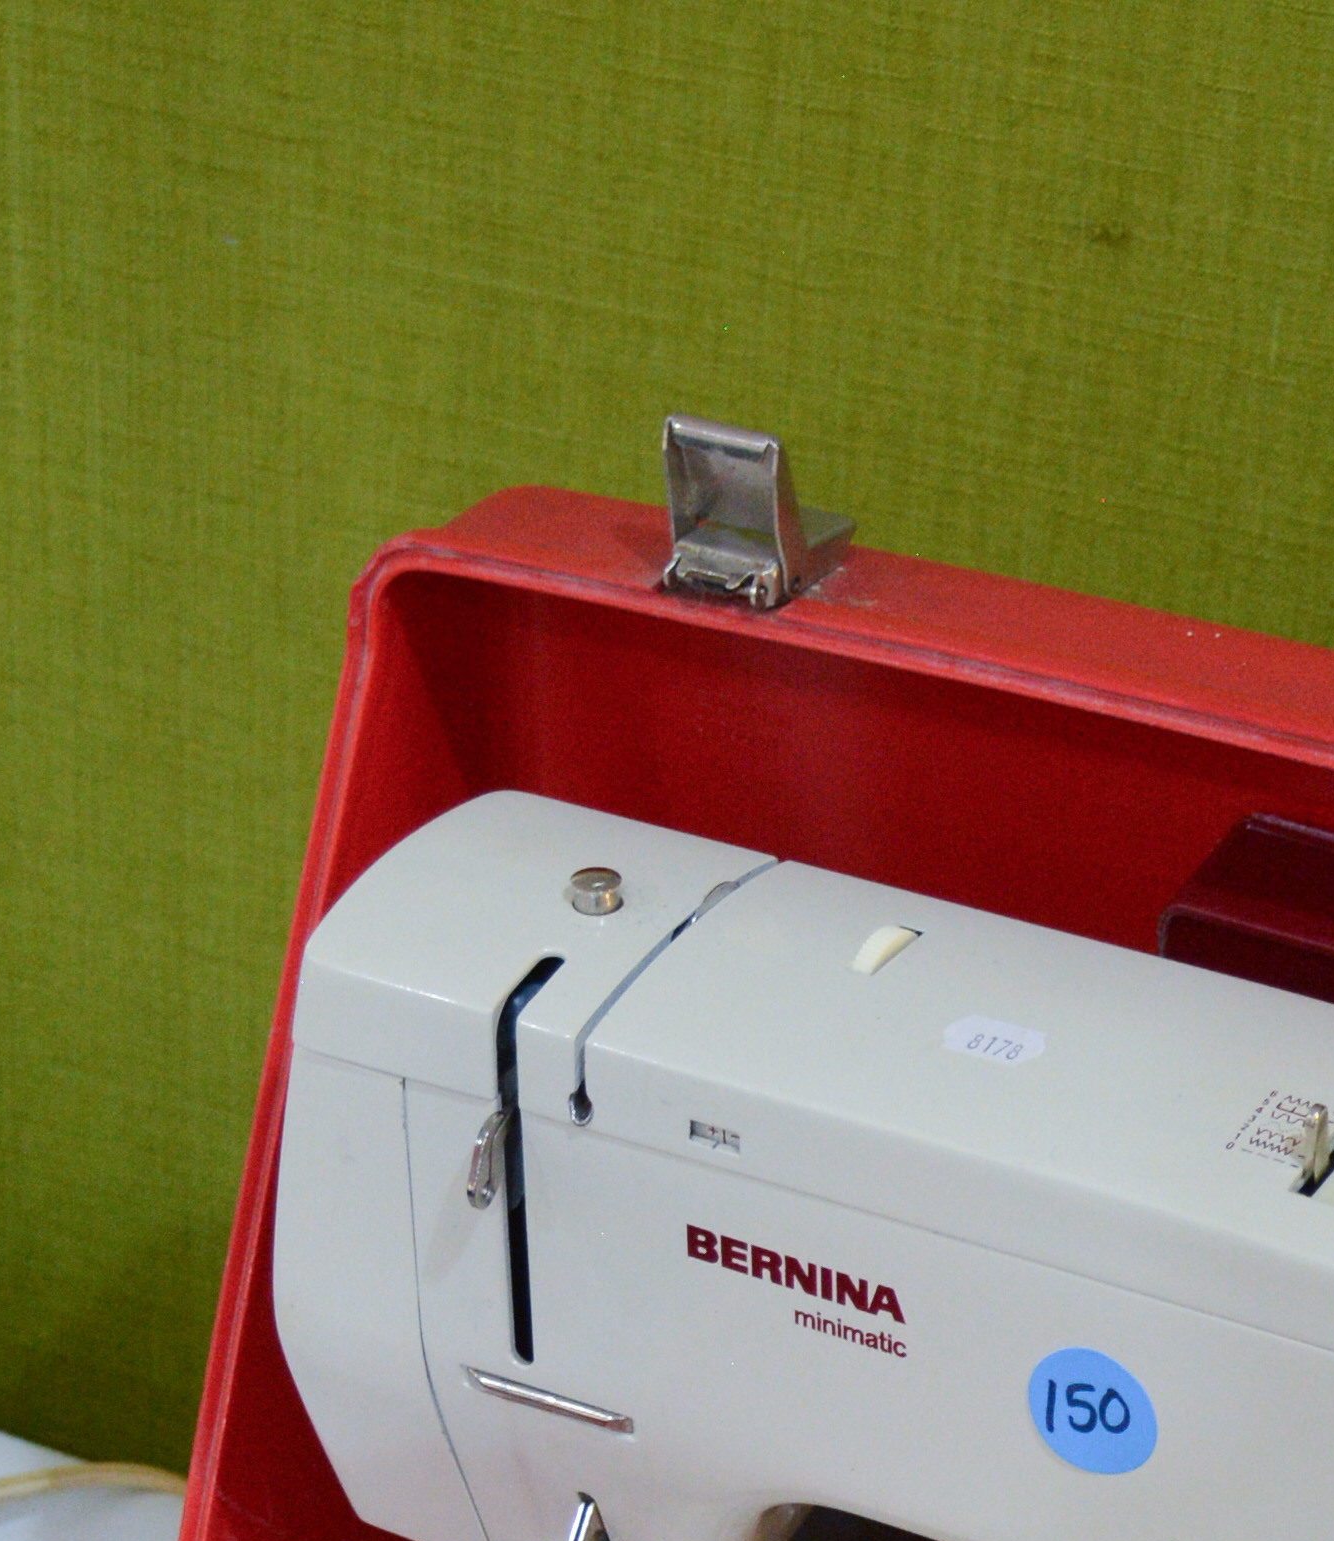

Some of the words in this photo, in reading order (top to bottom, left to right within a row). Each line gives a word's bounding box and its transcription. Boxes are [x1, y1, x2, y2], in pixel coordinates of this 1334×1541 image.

[967, 1033, 1024, 1060] 8178
[685, 1223, 907, 1325] BERNINA
[793, 1305, 908, 1359] minimatic
[1044, 1378, 1132, 1435] 150
